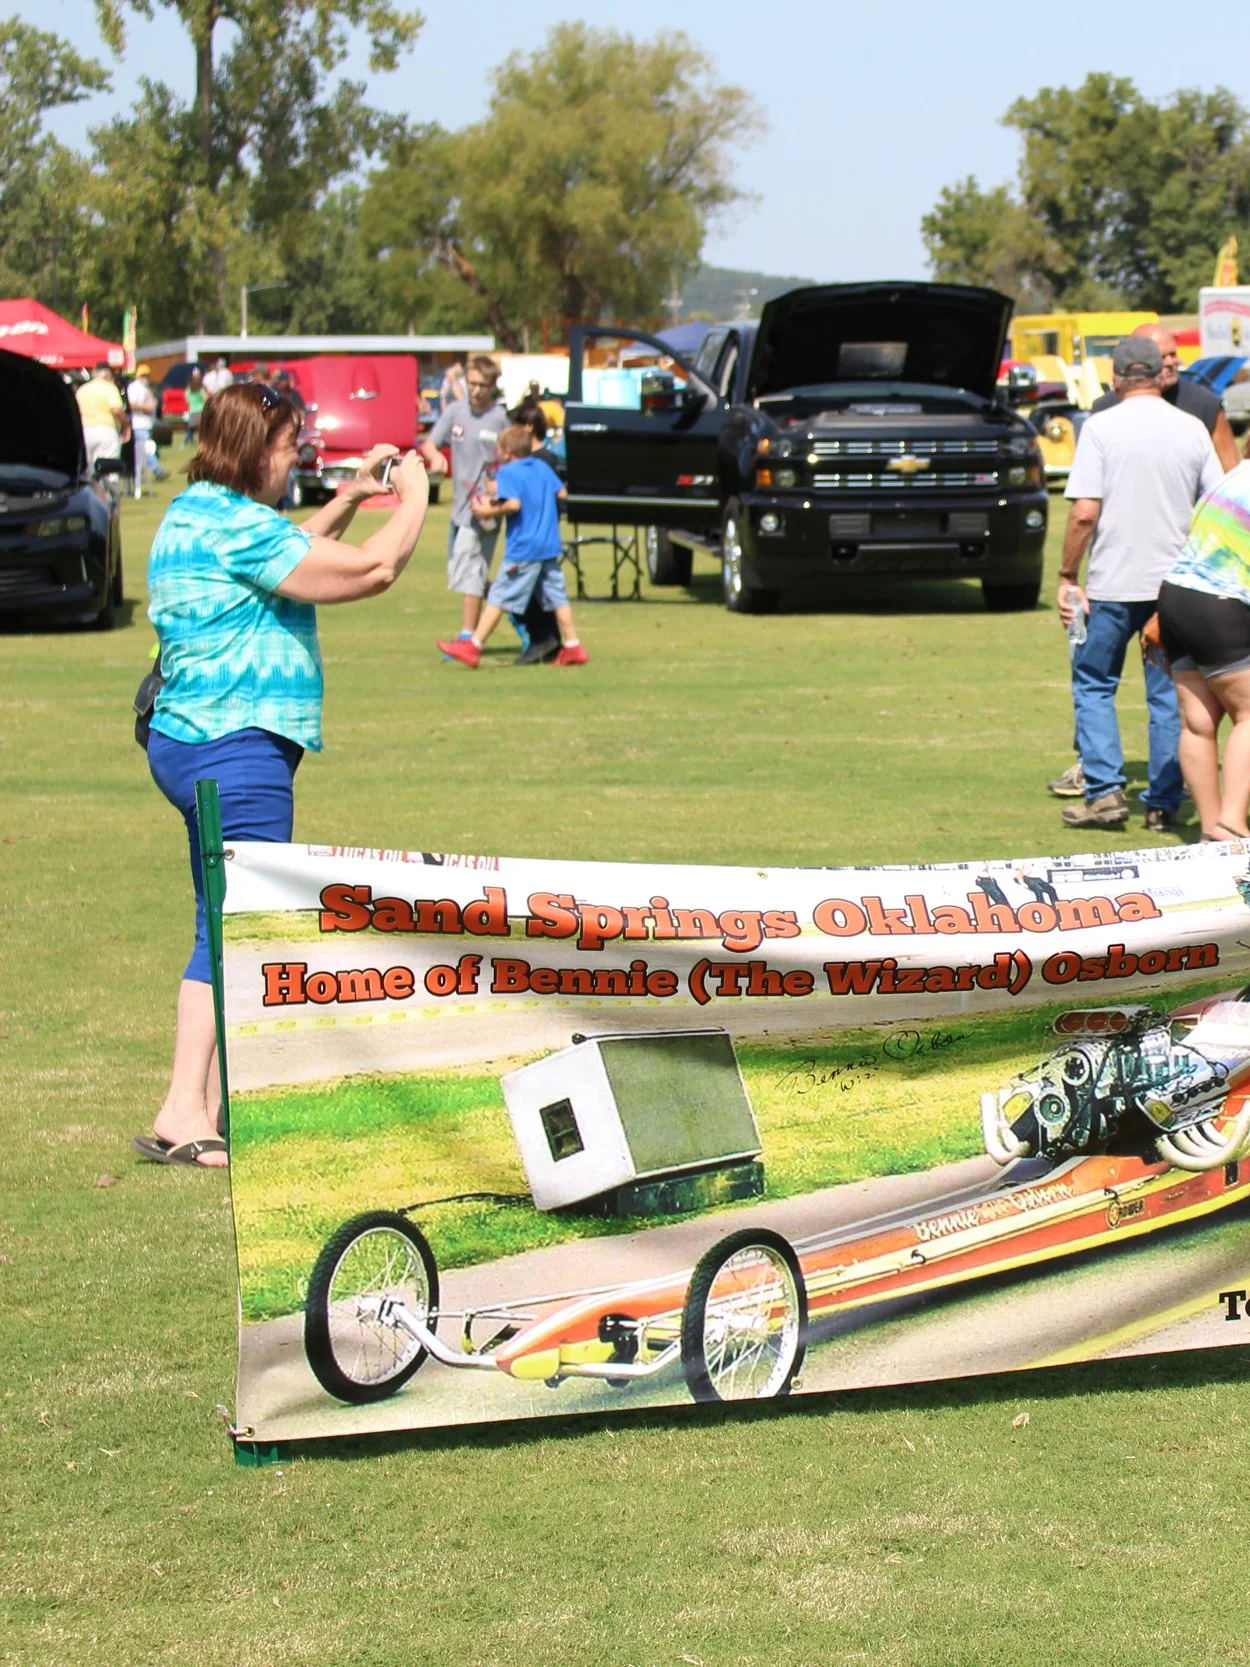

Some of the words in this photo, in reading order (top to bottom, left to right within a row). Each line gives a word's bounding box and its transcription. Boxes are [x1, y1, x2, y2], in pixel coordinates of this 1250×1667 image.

[318, 882, 511, 938] Sand
[526, 890, 802, 951] Springs
[812, 891, 1162, 936] Oklahoma
[262, 962, 415, 1007] Home
[423, 954, 483, 996] of
[490, 957, 679, 997] Bennie
[687, 957, 814, 1006] (The
[824, 948, 1032, 996] Wizard)
[1041, 940, 1220, 985] Osborn
